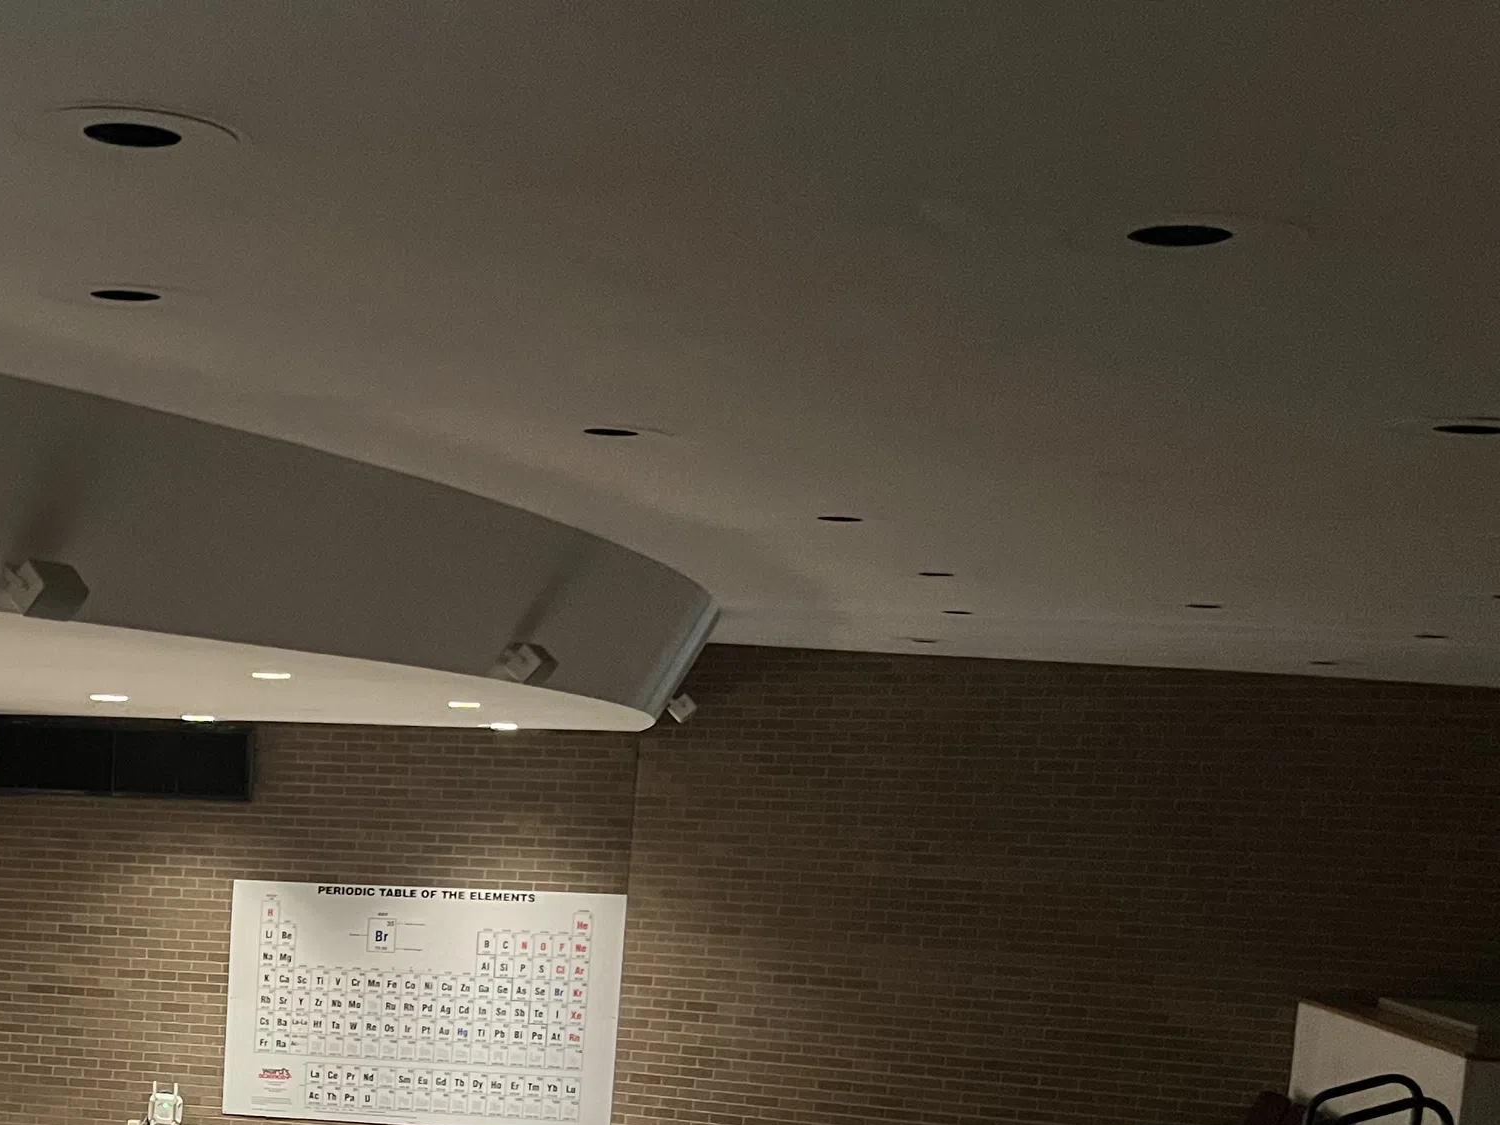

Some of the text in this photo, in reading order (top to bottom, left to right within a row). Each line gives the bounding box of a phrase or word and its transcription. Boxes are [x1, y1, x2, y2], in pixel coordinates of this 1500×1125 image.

[318, 886, 536, 902] PERIODIC TABLE OF THE ELEMENTS
[282, 931, 292, 939] Be
[375, 930, 388, 942] Br
[484, 940, 490, 948] B
[503, 940, 509, 949] C
[540, 942, 546, 951] O
[559, 943, 565, 952] F
[263, 952, 292, 963] Na Mg
[520, 964, 526, 972] P
[539, 965, 544, 973] S
[574, 966, 584, 975] Ar
[279, 975, 290, 983] Ca
[297, 976, 307, 984] Sc
[335, 977, 341, 986] V
[351, 978, 360, 986] Cr
[387, 980, 397, 988] Fe
[405, 981, 416, 989] Co
[441, 982, 452, 991] Cu
[460, 983, 470, 992] Zn
[478, 984, 490, 993] Ga
[497, 985, 508, 994] Ge
[516, 986, 527, 995] As
[535, 987, 545, 996] Se
[554, 988, 564, 996] Br
[261, 995, 271, 1004] Rb
[279, 996, 288, 1005] Sr
[315, 998, 323, 1006] Zr
[331, 1000, 342, 1008] Nb
[422, 1004, 433, 1012] Pd
[440, 1005, 451, 1015] Ag
[458, 1005, 470, 1014] Cd
[514, 1008, 525, 1017] Sb
[534, 1009, 543, 1018] Te
[260, 1017, 269, 1025] Cs
[277, 1018, 287, 1026] Ba
[366, 1023, 377, 1031] Re
[384, 1024, 395, 1032] Os
[421, 1026, 430, 1034] Pt
[457, 1028, 468, 1038] Hg
[494, 1029, 505, 1038] Pb
[551, 1033, 560, 1041] At
[259, 1038, 268, 1047] Fr
[276, 1040, 286, 1048] Ra
[310, 1070, 320, 1078] La
[327, 1071, 338, 1079] Ce
[346, 1072, 355, 1080] Pr
[363, 1074, 374, 1082] Nd
[398, 1075, 411, 1084] Sm
[435, 1077, 447, 1086] Gd
[455, 1078, 465, 1087] Tb
[473, 1080, 483, 1089] Dy
[528, 1083, 540, 1091] Tm
[547, 1084, 558, 1092] Yb
[309, 1092, 319, 1100] Ac
[327, 1092, 337, 1100] Th
[344, 1093, 355, 1102] Pa
